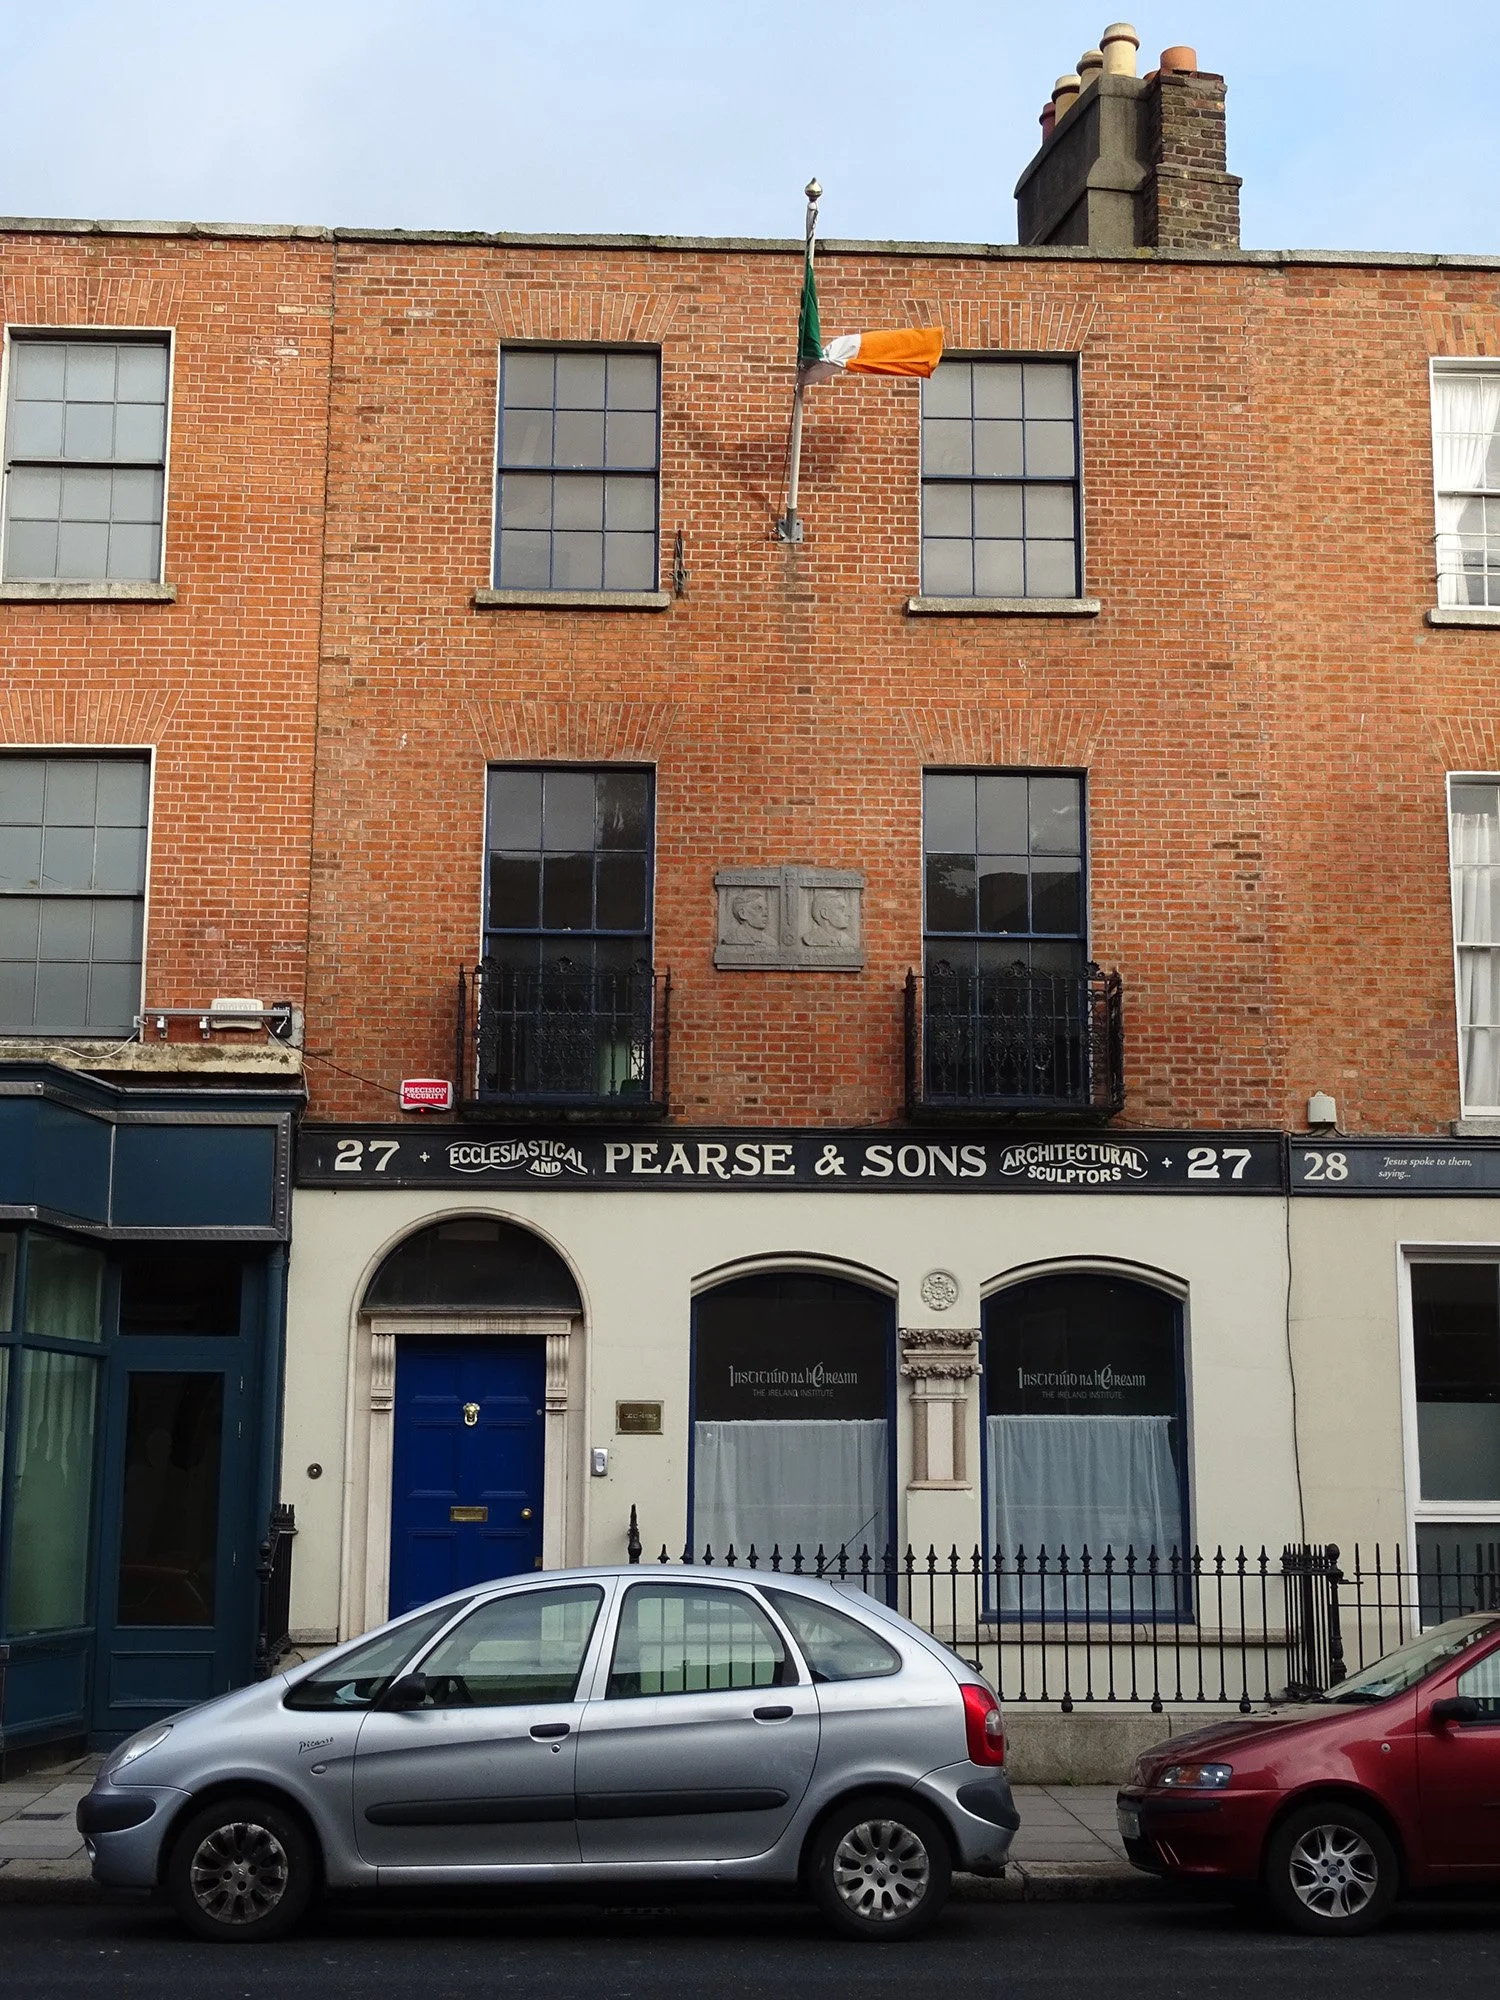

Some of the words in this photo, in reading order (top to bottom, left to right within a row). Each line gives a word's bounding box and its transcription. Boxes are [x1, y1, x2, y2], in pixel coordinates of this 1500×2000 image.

[335, 1140, 400, 1171] 27
[449, 1140, 588, 1173] ECCLESIASTICAL
[530, 1160, 561, 1174] AND
[603, 1143, 795, 1179] PEARSE
[814, 1144, 847, 1176] &
[861, 1145, 987, 1177] SONS
[1002, 1144, 1142, 1172] ARCHITECTURAL
[1187, 1147, 1252, 1179] 27
[1303, 1152, 1349, 1181] 28
[1409, 1157, 1435, 1167] spoke
[1436, 1158, 1446, 1166] to
[1448, 1157, 1472, 1167] them,
[1027, 1165, 1122, 1184] SCULPTORS
[1378, 1169, 1411, 1180] saying...
[753, 1389, 766, 1397] THE
[767, 1389, 798, 1397] IRELAND
[800, 1389, 834, 1398] INSTITUTE
[1042, 1391, 1055, 1399] THE
[1057, 1391, 1087, 1399] IRELAND
[1089, 1391, 1123, 1399] INSTITUTE
